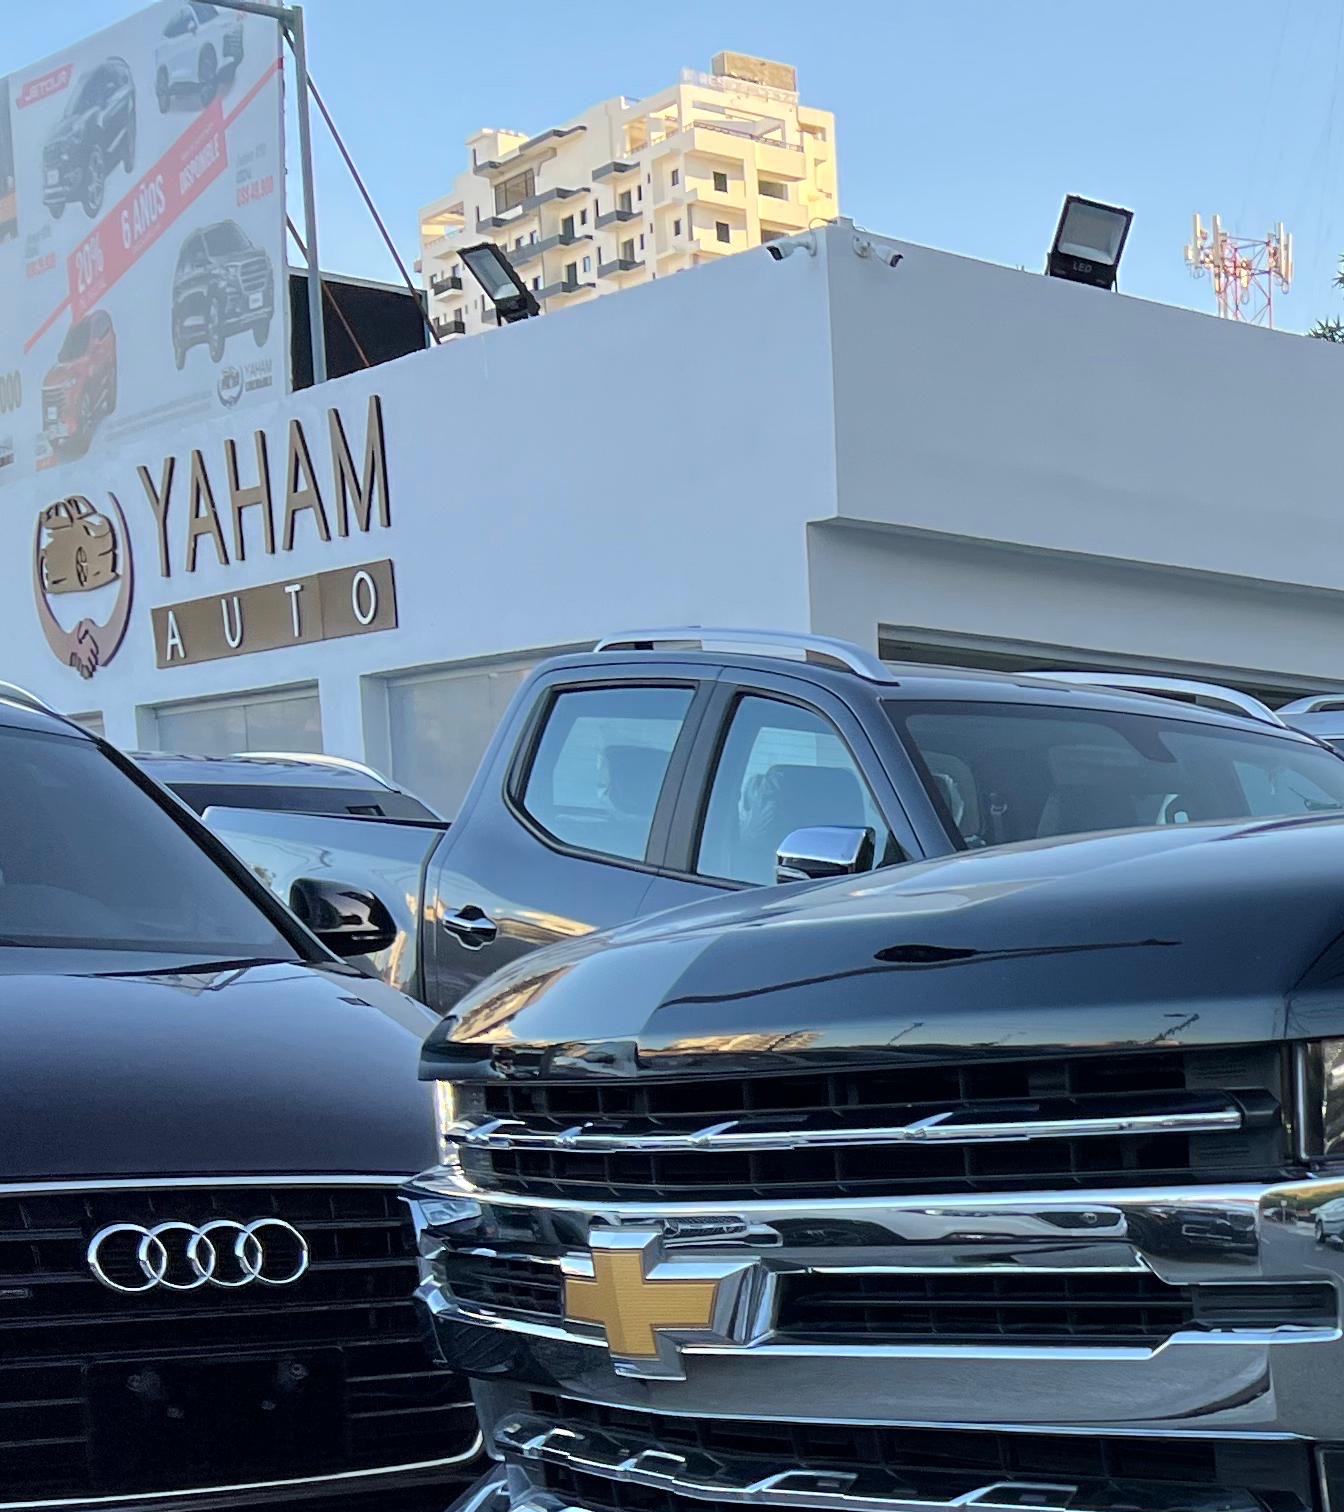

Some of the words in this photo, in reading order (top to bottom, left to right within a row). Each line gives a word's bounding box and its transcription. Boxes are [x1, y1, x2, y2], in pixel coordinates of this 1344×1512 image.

[22, 68, 69, 102] JETOUR
[120, 208, 132, 249] 6
[133, 173, 166, 241] AÑOS
[75, 231, 105, 294] 20%
[136, 394, 391, 578] YAHAM
[166, 570, 377, 661] AUTO
